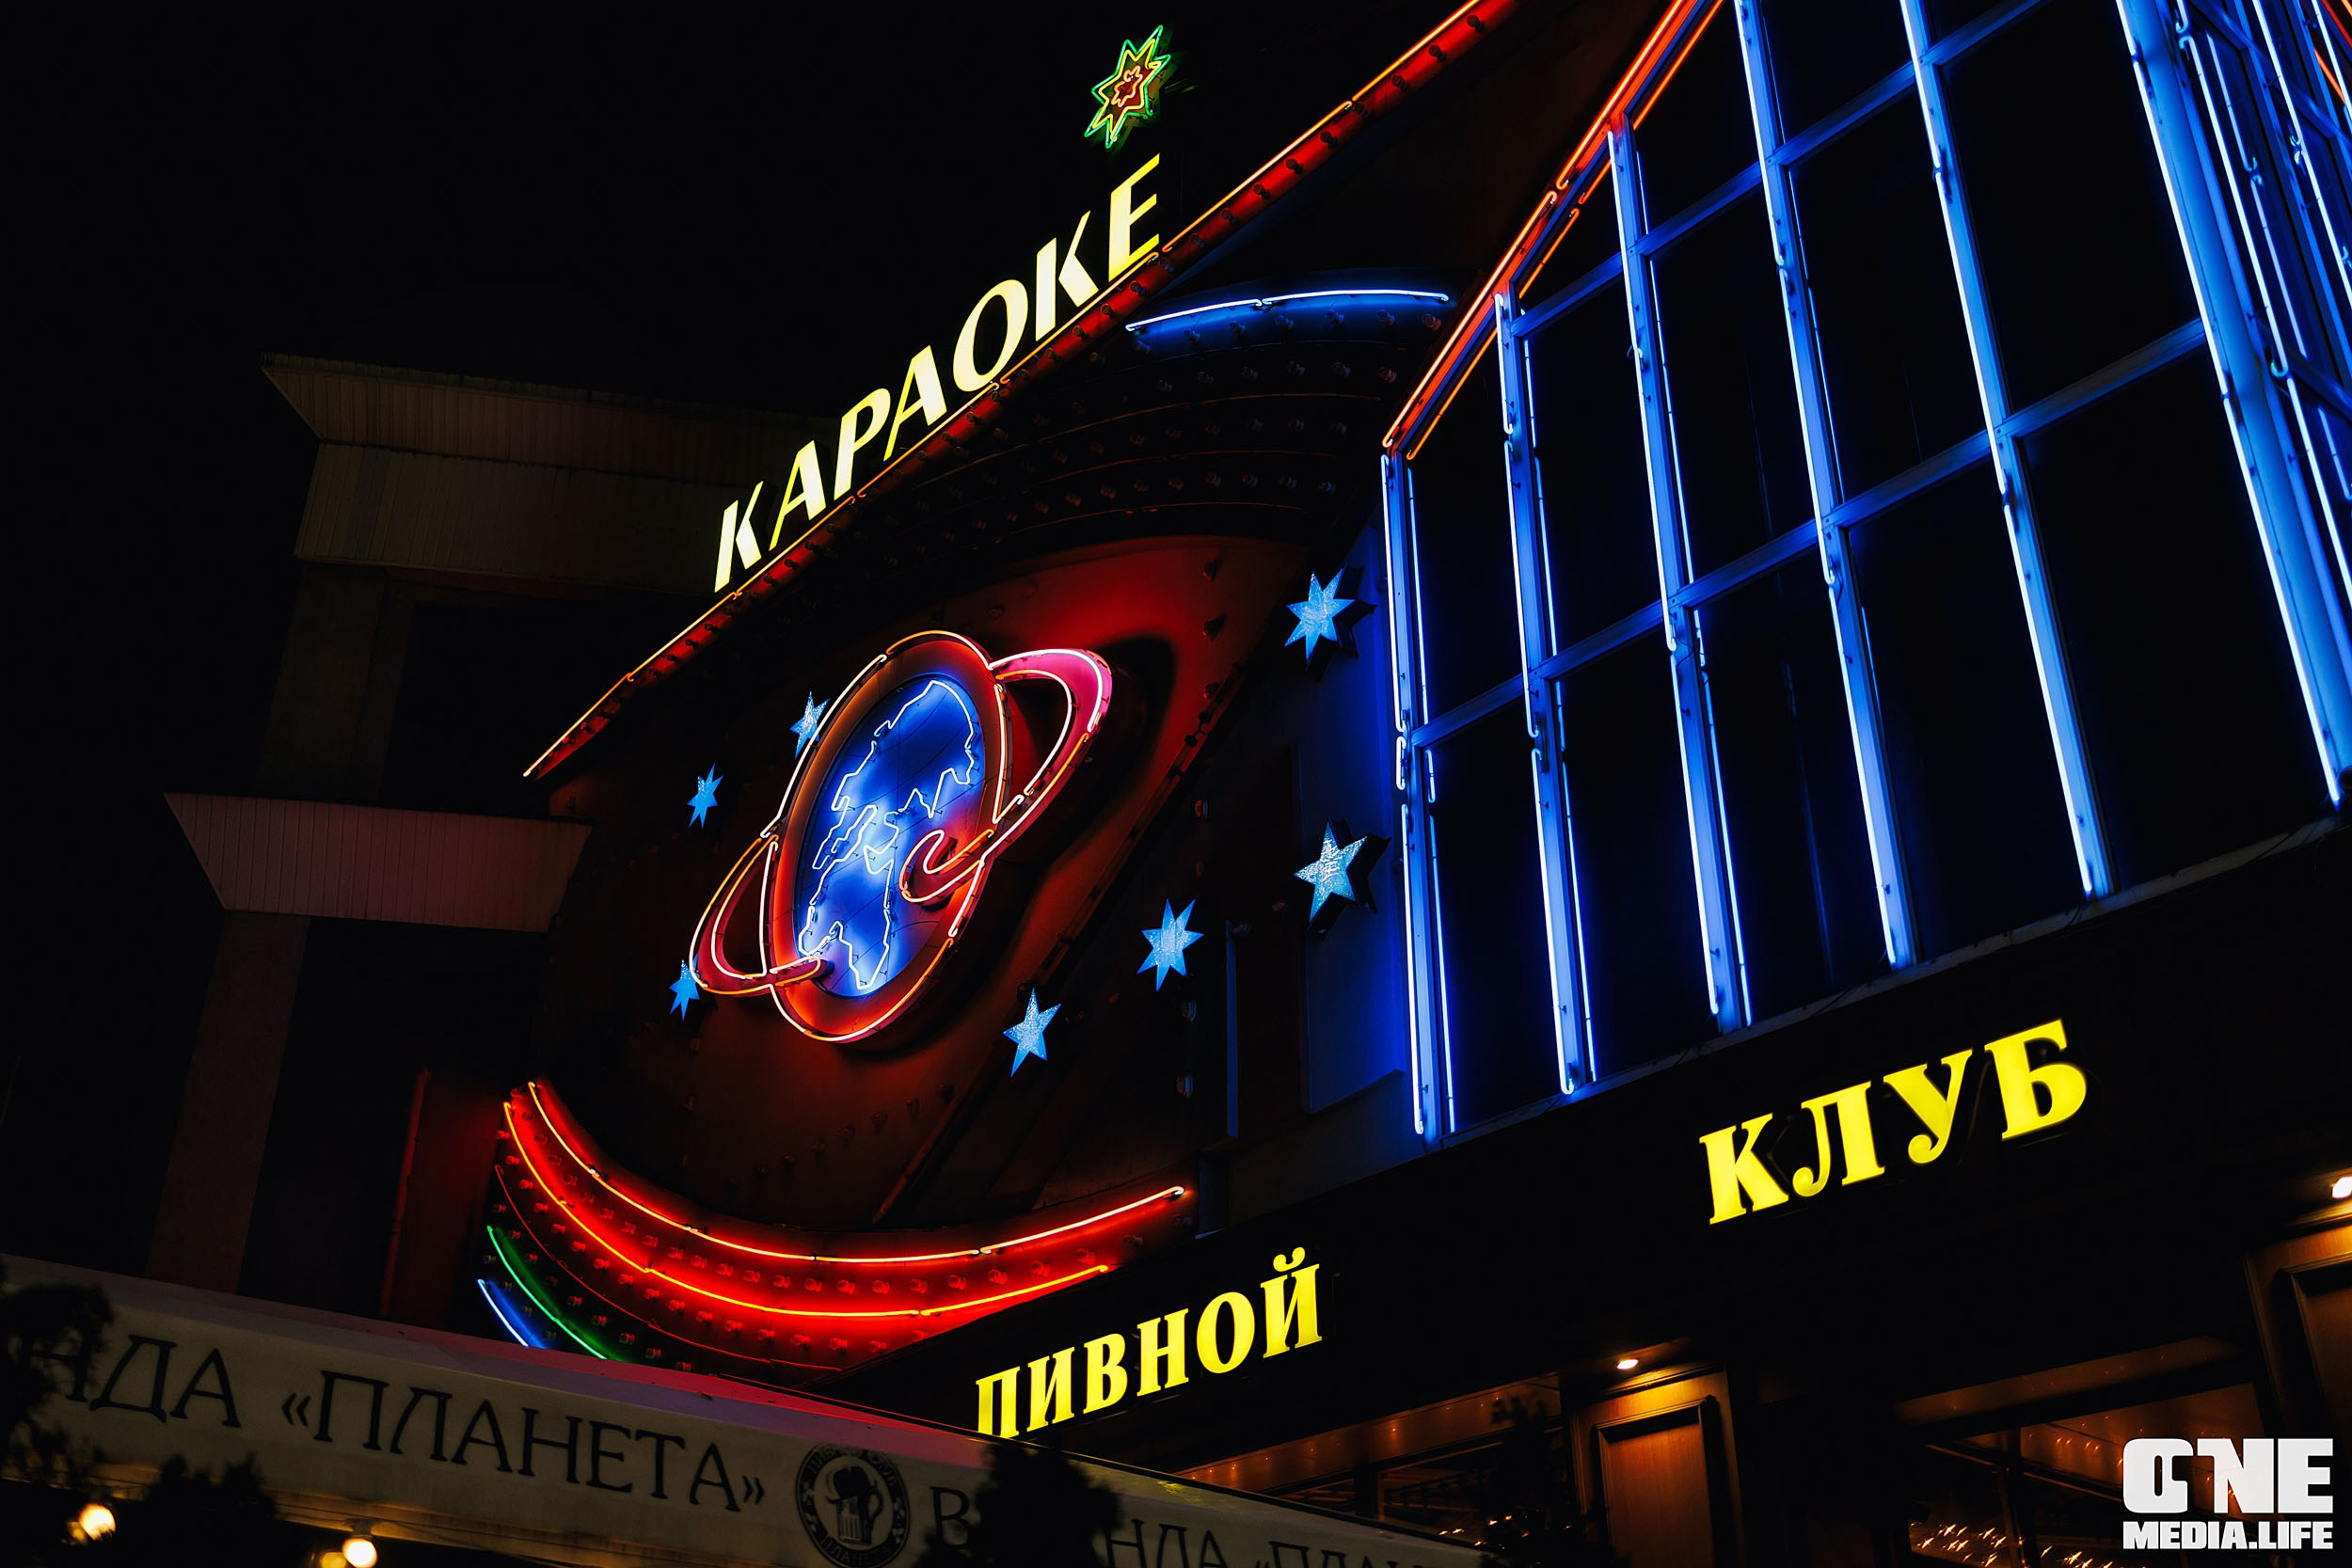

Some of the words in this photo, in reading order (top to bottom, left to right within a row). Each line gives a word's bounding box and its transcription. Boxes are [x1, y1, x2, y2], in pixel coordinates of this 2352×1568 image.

[714, 152, 1160, 593] КАРАОКЕ
[975, 1246, 1323, 1440] ПИВНОЙ
[1698, 1019, 2088, 1225] КЛУБ
[282, 1370, 764, 1512] «ПЛАНЕТА»
